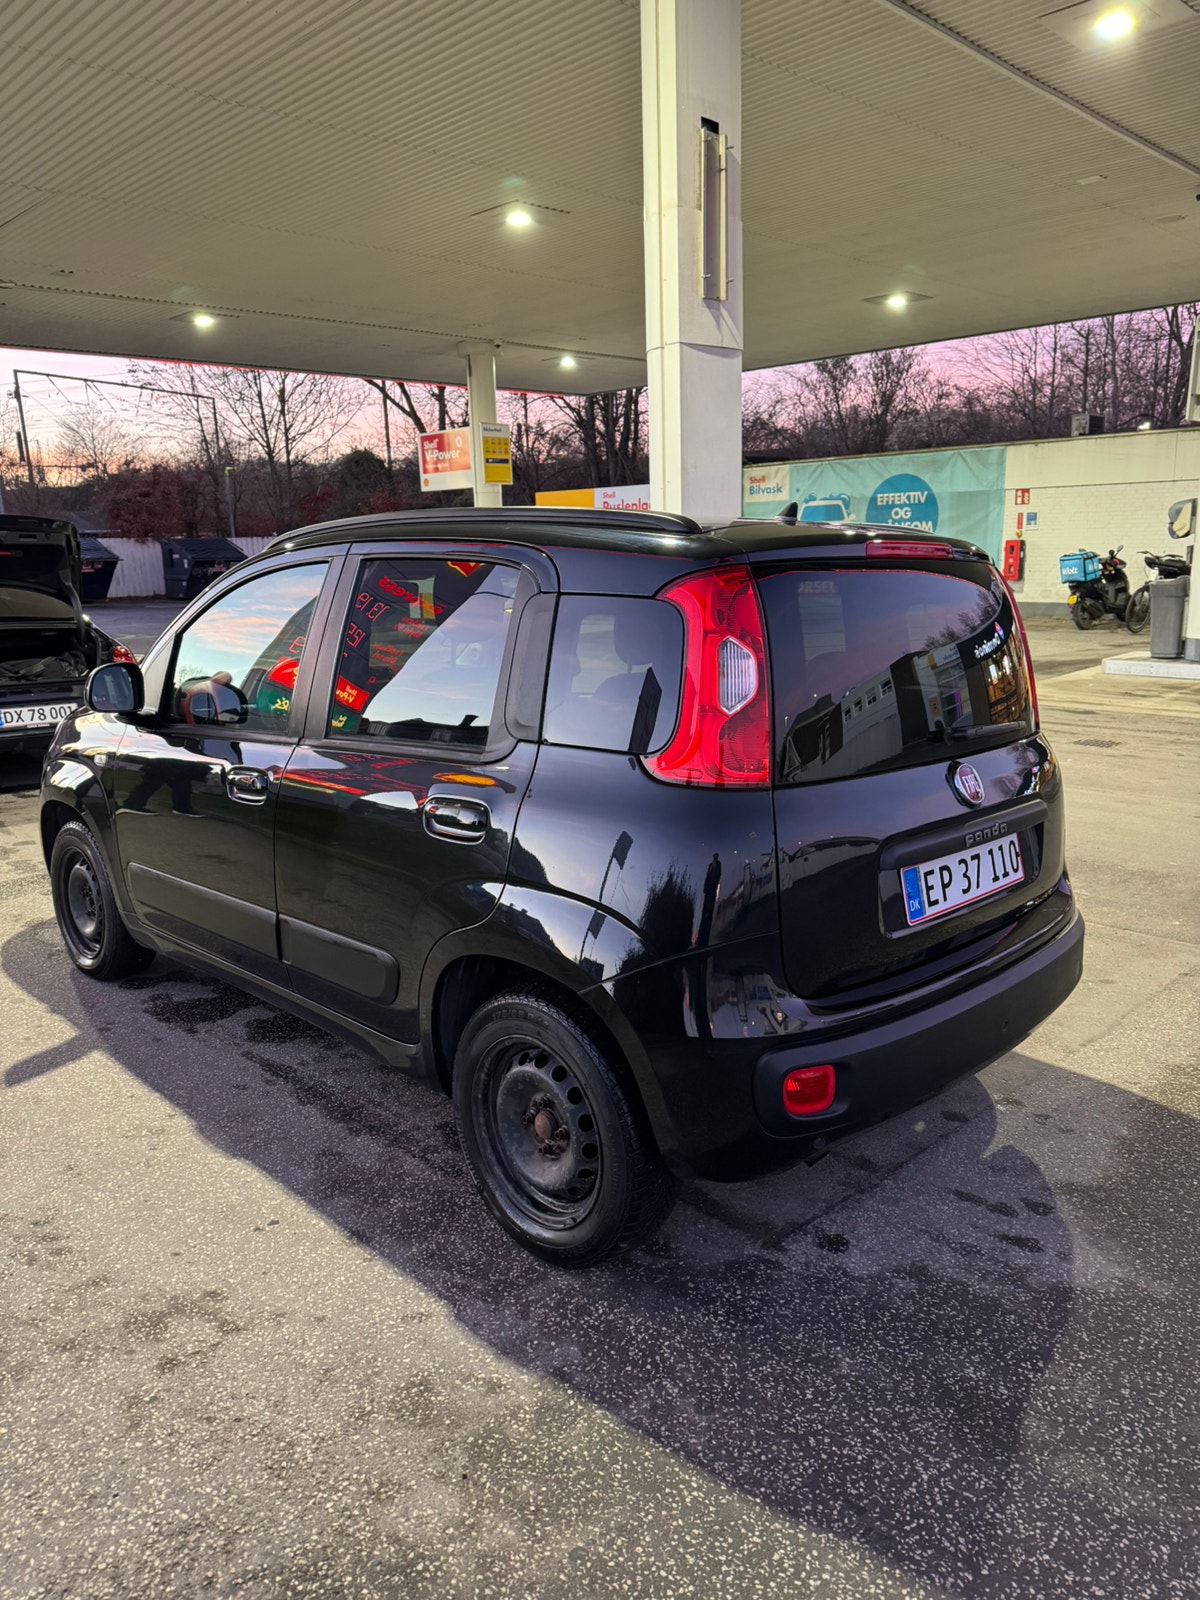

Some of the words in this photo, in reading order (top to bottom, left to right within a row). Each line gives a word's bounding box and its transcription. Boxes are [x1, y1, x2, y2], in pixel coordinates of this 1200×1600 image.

[423, 439, 438, 449] Shell
[424, 449, 461, 461] V-Power
[749, 475, 766, 484] Shell
[602, 491, 616, 499] Shell
[749, 483, 783, 495] Bilvask
[876, 490, 929, 506] EFFEKTIV
[890, 506, 912, 520] OG
[3, 709, 25, 724] DX
[27, 708, 47, 722] 78
[923, 864, 953, 908] EP
[957, 853, 981, 895] 37
[987, 839, 1020, 884] 110
[909, 899, 921, 913] DK
